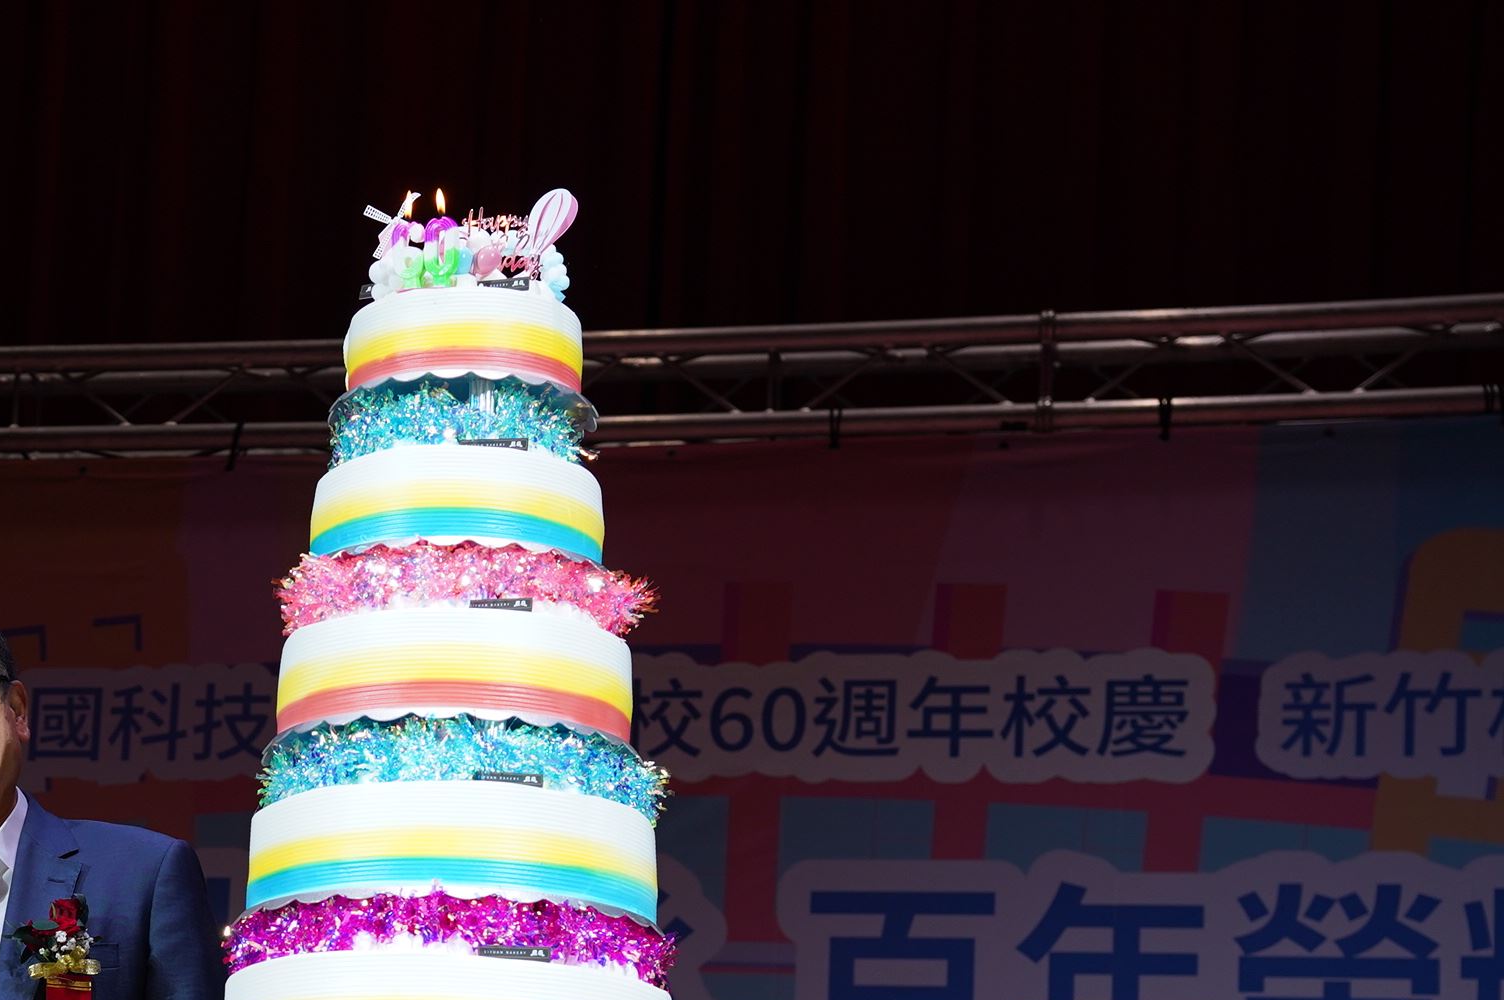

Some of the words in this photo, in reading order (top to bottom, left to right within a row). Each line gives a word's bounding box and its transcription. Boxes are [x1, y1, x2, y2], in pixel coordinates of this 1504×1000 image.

[27, 682, 271, 761] 國科技
[632, 672, 1190, 760] 校60週年校慶
[1281, 672, 1504, 757] 新竹
